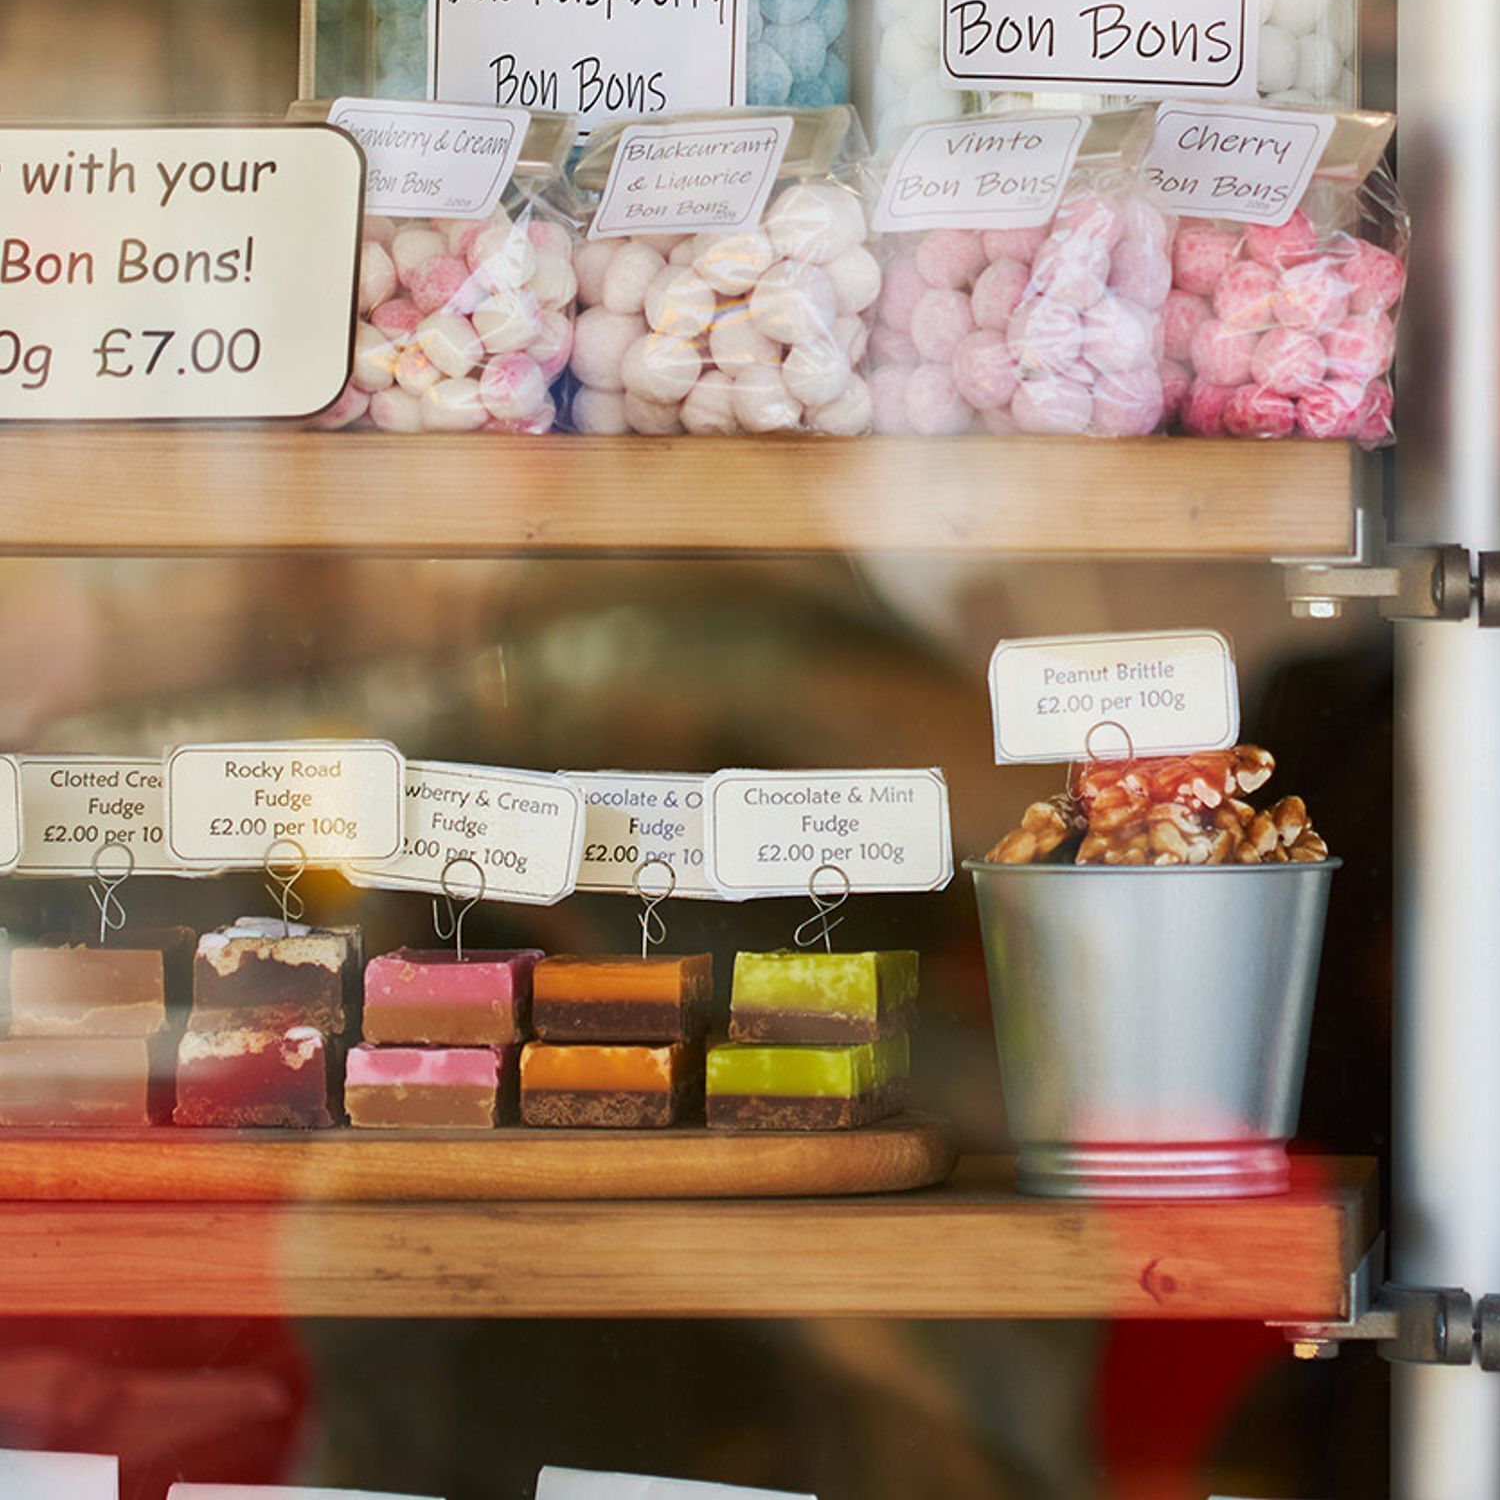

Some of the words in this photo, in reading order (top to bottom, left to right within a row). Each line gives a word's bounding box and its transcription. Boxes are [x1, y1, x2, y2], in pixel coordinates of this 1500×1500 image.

[950, 0, 1054, 57] Bon
[1079, 3, 1232, 63] Bons
[489, 54, 557, 111] Bon
[572, 57, 667, 113] Bons
[434, 129, 449, 151] &
[624, 139, 776, 162] Blackcurrant
[947, 130, 1043, 156] Vimto
[1178, 125, 1292, 164] Cherry
[22, 148, 136, 195] with
[157, 161, 277, 207] your
[401, 171, 444, 197] Bons
[899, 174, 960, 201] Bon
[975, 171, 1057, 198] Bons
[1212, 175, 1290, 203] Bons
[625, 202, 666, 219] Bon
[677, 200, 729, 216] Bons
[1, 238, 94, 285] Bon
[117, 236, 253, 284] Bons!
[0, 330, 52, 389] 0g
[93, 328, 261, 378] £7.00
[1043, 666, 1109, 686] Peanut
[1117, 661, 1175, 681] Brittle
[1036, 694, 1094, 715] £2.00
[1100, 694, 1132, 715] per
[1139, 689, 1186, 713] 100g
[50, 770, 119, 788] Clotted
[225, 760, 284, 781] Rocky
[291, 761, 342, 778] Road
[254, 789, 312, 811] Fudge
[474, 790, 490, 807] &
[498, 791, 559, 816] Cream
[663, 790, 680, 807] &
[743, 787, 841, 805] Chocolate
[848, 786, 864, 804] &
[869, 786, 915, 804] Mint
[88, 798, 145, 819] Fudge
[43, 825, 98, 843] £2.00
[104, 832, 135, 844] per
[142, 826, 163, 843] 10
[209, 818, 267, 836] £2.00
[273, 824, 305, 839] per
[312, 818, 358, 839] 100g
[431, 812, 488, 837] Fudge
[629, 817, 685, 841] Fudge
[802, 814, 860, 836] Fudge
[445, 847, 476, 864] per
[484, 846, 527, 874] 100g
[583, 844, 639, 863] £2.00
[646, 852, 676, 867] per
[683, 849, 704, 866] 10
[757, 844, 815, 862] £2.00
[821, 849, 853, 864] per
[860, 843, 905, 865] 100g
